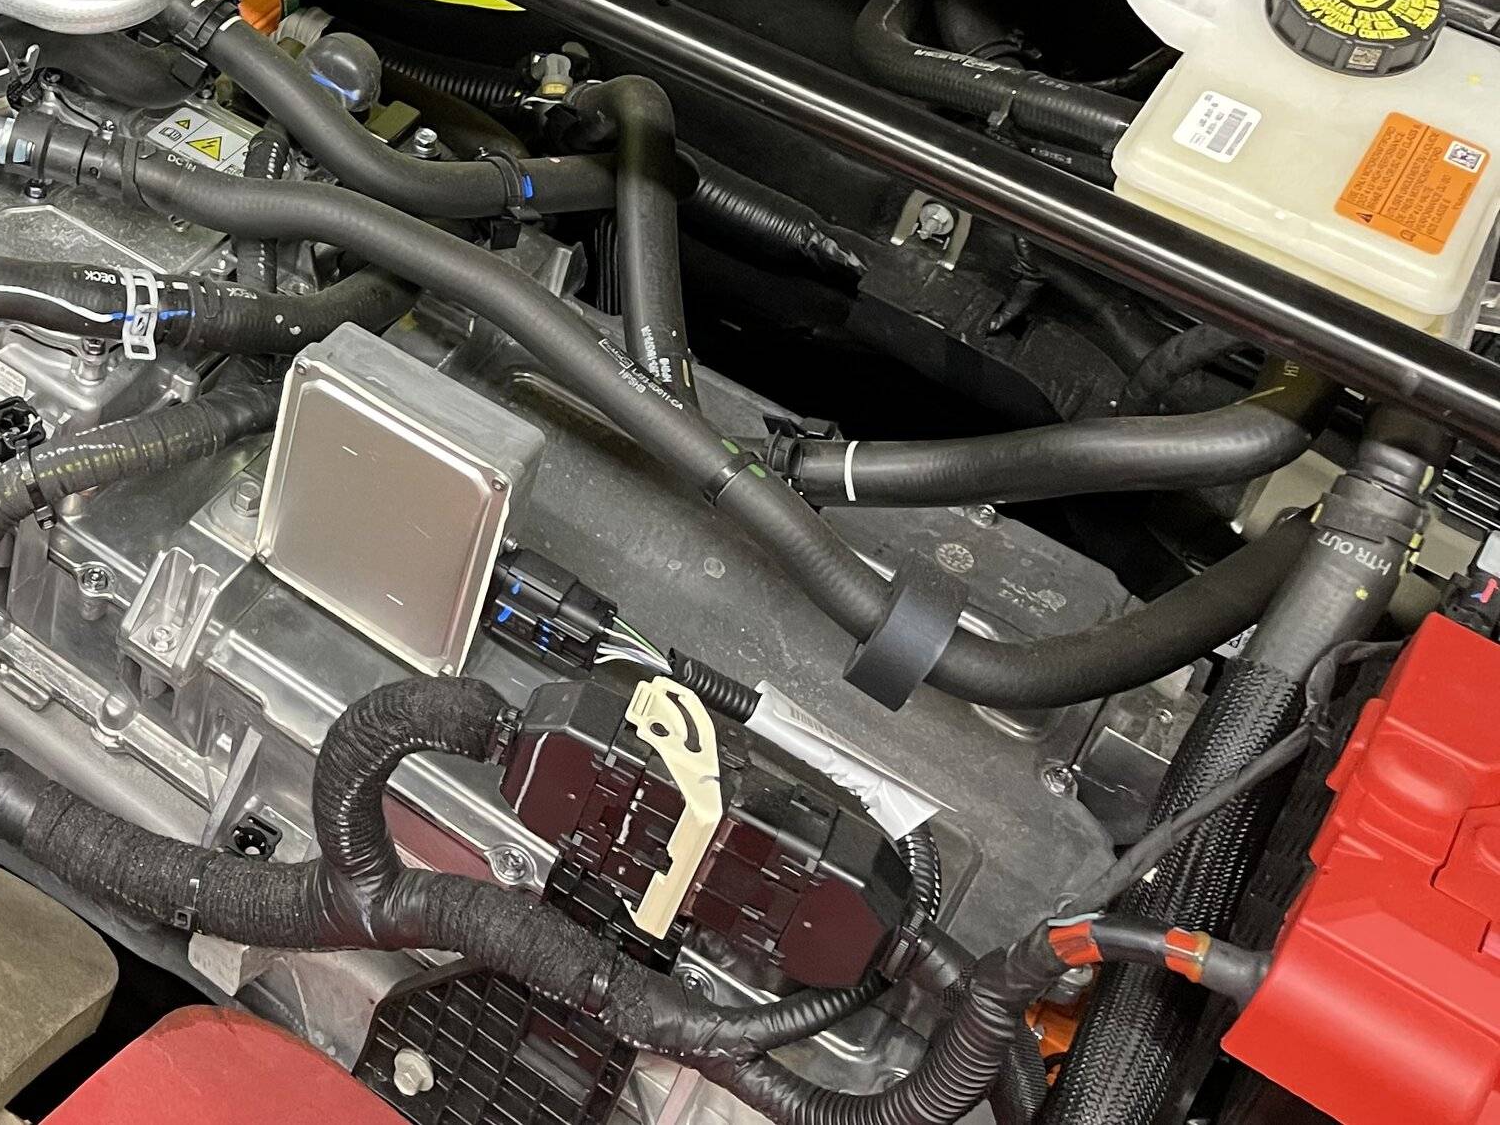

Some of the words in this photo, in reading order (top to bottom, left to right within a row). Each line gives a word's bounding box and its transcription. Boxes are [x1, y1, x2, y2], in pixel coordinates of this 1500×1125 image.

[167, 154, 183, 165] DC
[84, 269, 115, 284] DECK
[1317, 530, 1354, 555] OUT
[1354, 546, 1391, 576] HTR
